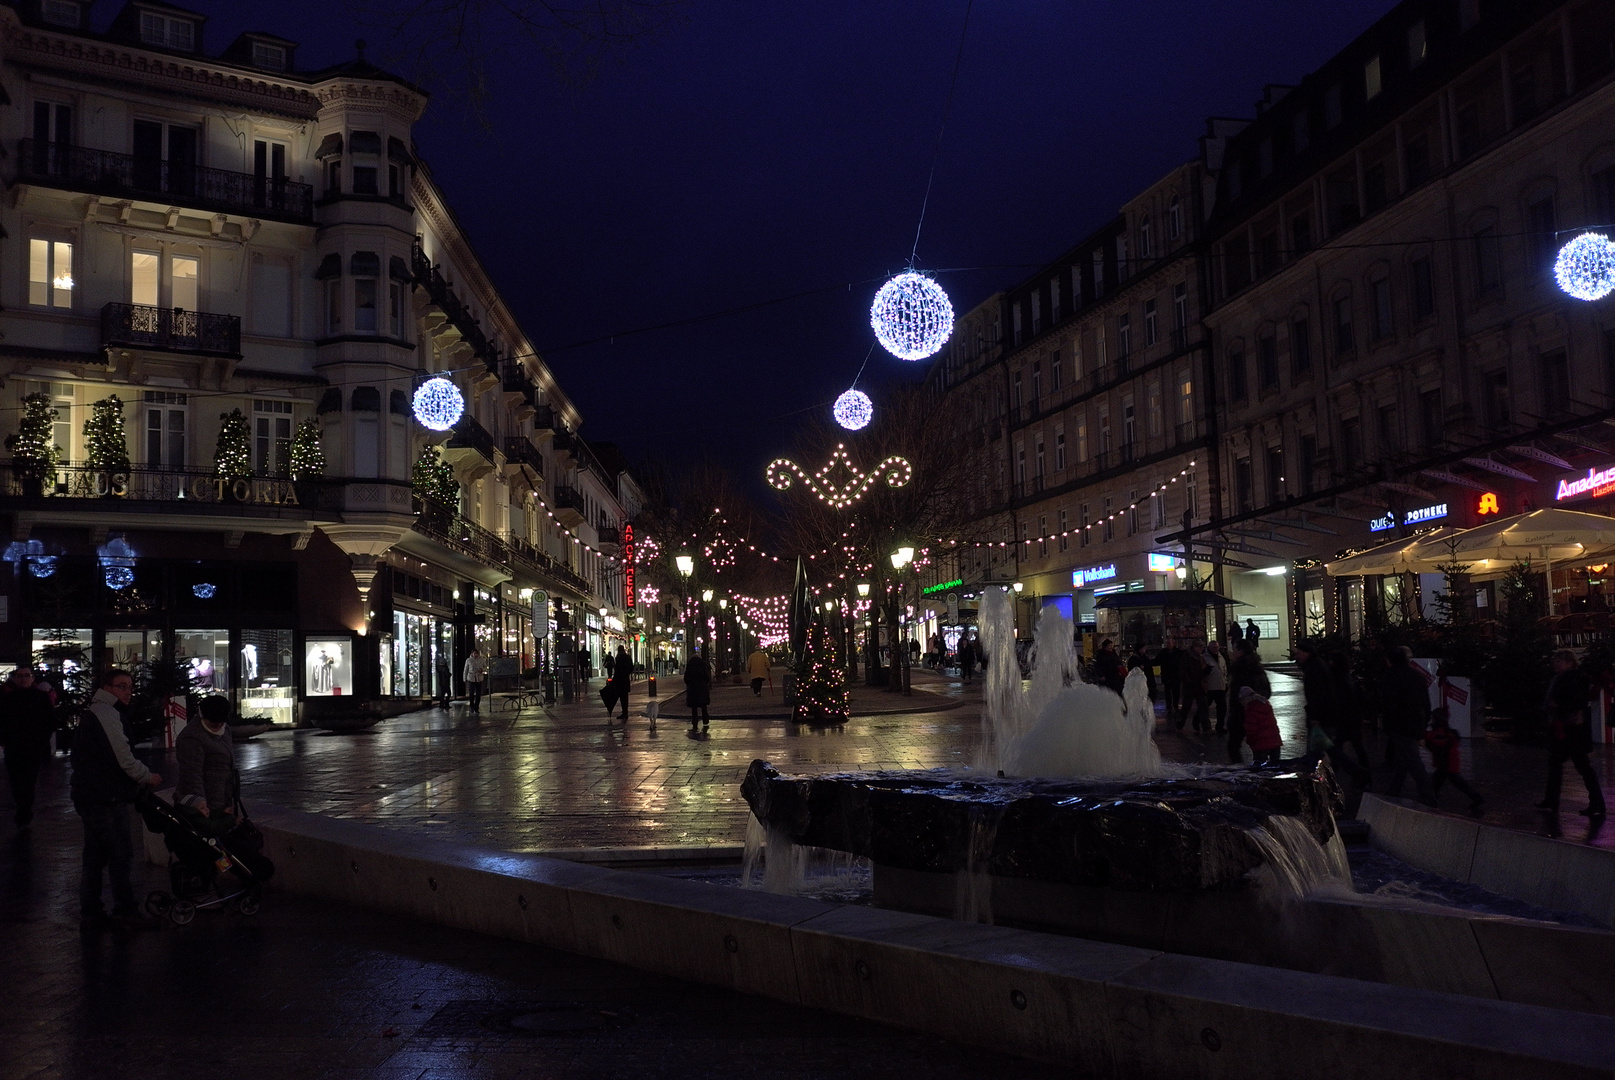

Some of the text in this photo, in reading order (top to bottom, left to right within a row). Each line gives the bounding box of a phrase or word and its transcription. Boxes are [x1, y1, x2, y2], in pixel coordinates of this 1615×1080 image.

[55, 473, 128, 496] HAUS
[1556, 467, 1615, 500] Amadeus
[1404, 503, 1448, 525] POTHEKE
[625, 524, 634, 607] APOTHEKE
[1084, 564, 1116, 582] Volksbank
